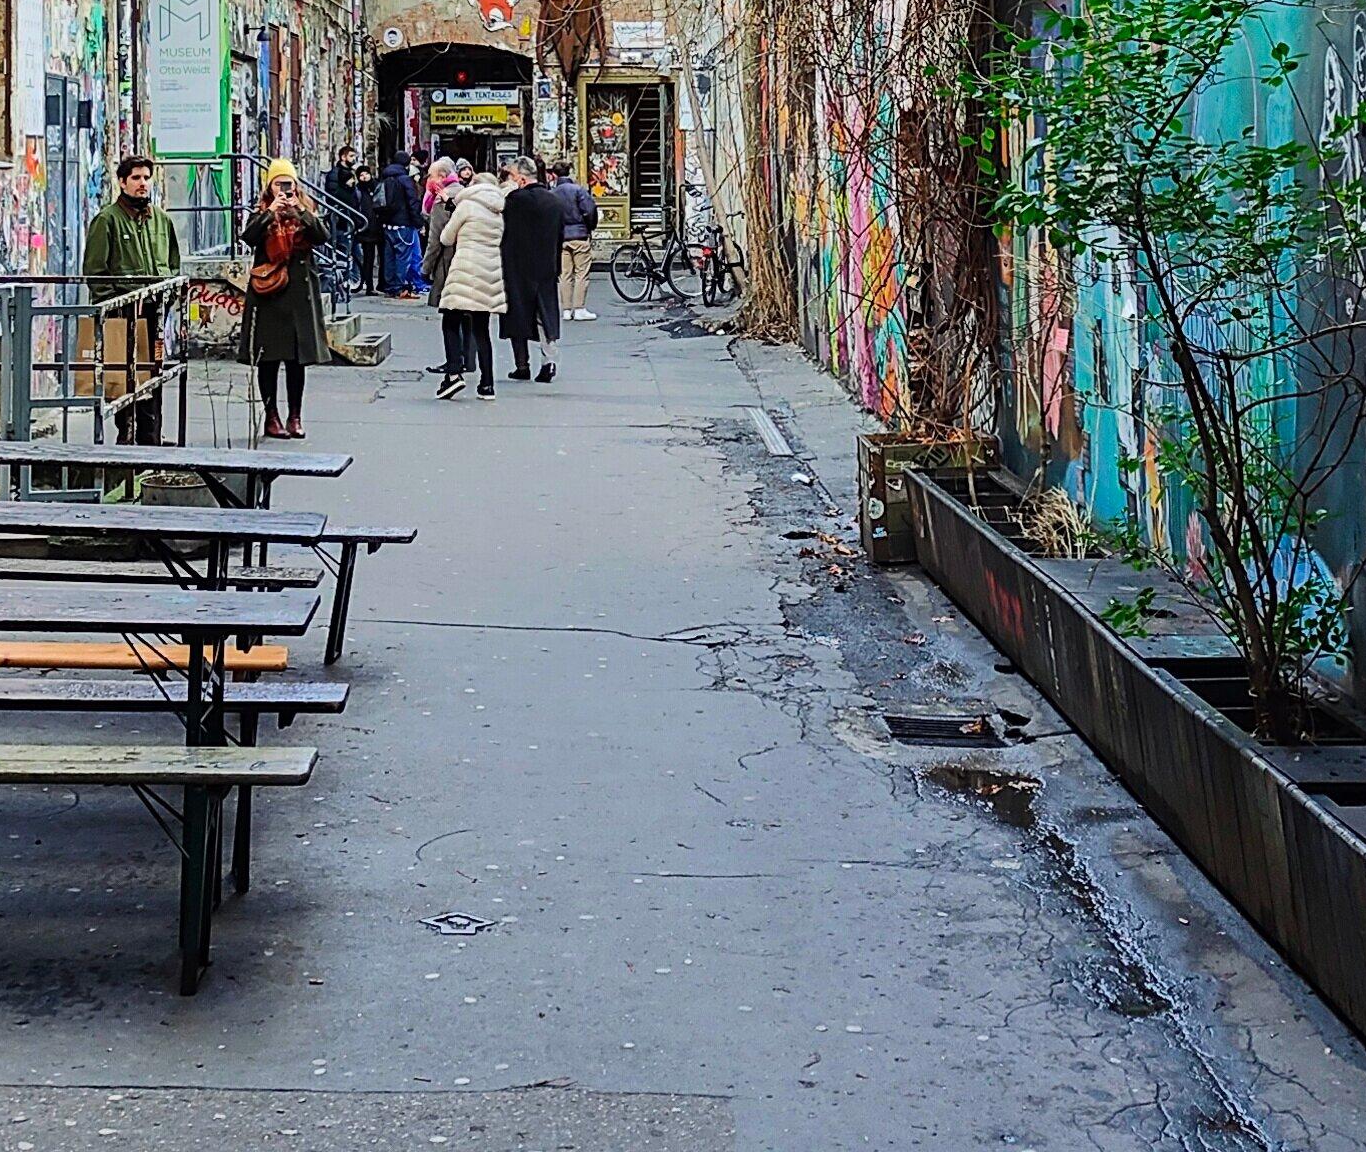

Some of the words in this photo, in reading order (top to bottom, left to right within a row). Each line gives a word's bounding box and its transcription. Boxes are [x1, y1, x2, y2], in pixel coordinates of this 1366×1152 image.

[159, 47, 211, 58] MUSEUM
[159, 65, 182, 75] Otto
[183, 65, 211, 75] Weidt
[453, 91, 471, 99] MANY
